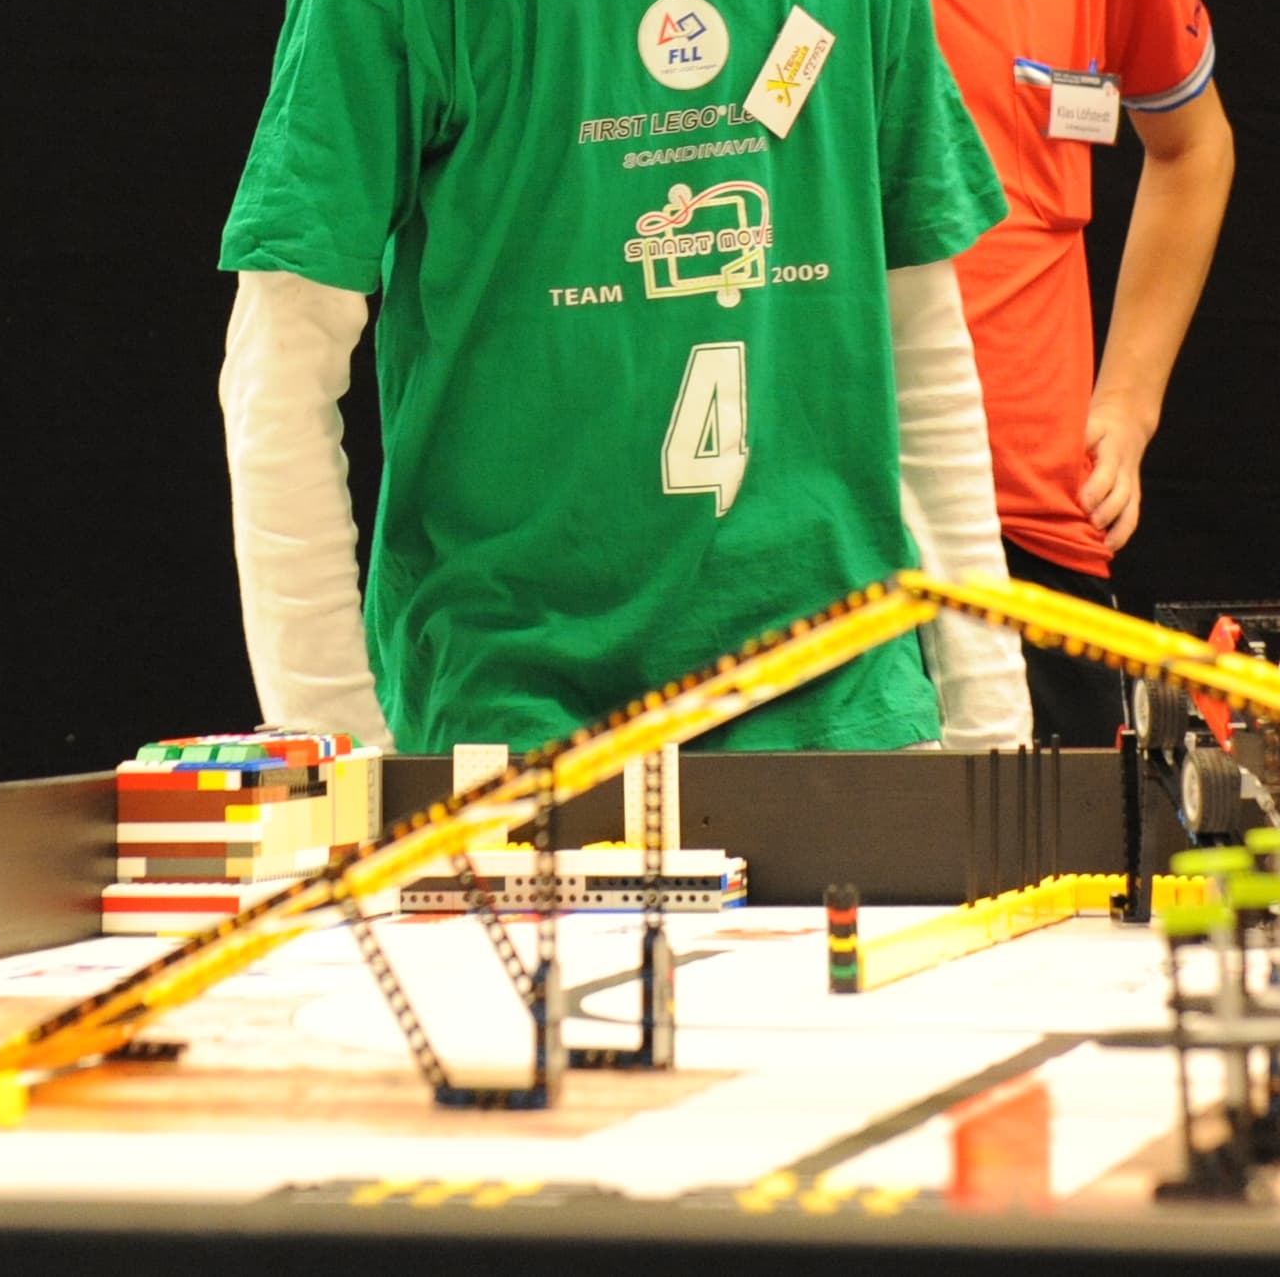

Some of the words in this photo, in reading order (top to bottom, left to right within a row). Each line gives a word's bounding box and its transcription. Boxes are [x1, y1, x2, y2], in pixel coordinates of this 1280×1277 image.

[668, 45, 702, 65] FLL
[578, 115, 647, 144] FIRST
[623, 137, 768, 169] SCANDINAVIA
[625, 233, 712, 262] SMART
[718, 226, 773, 252] MOVE
[771, 263, 830, 284] 2009
[549, 285, 624, 307] TEAM
[661, 341, 749, 518] 4
